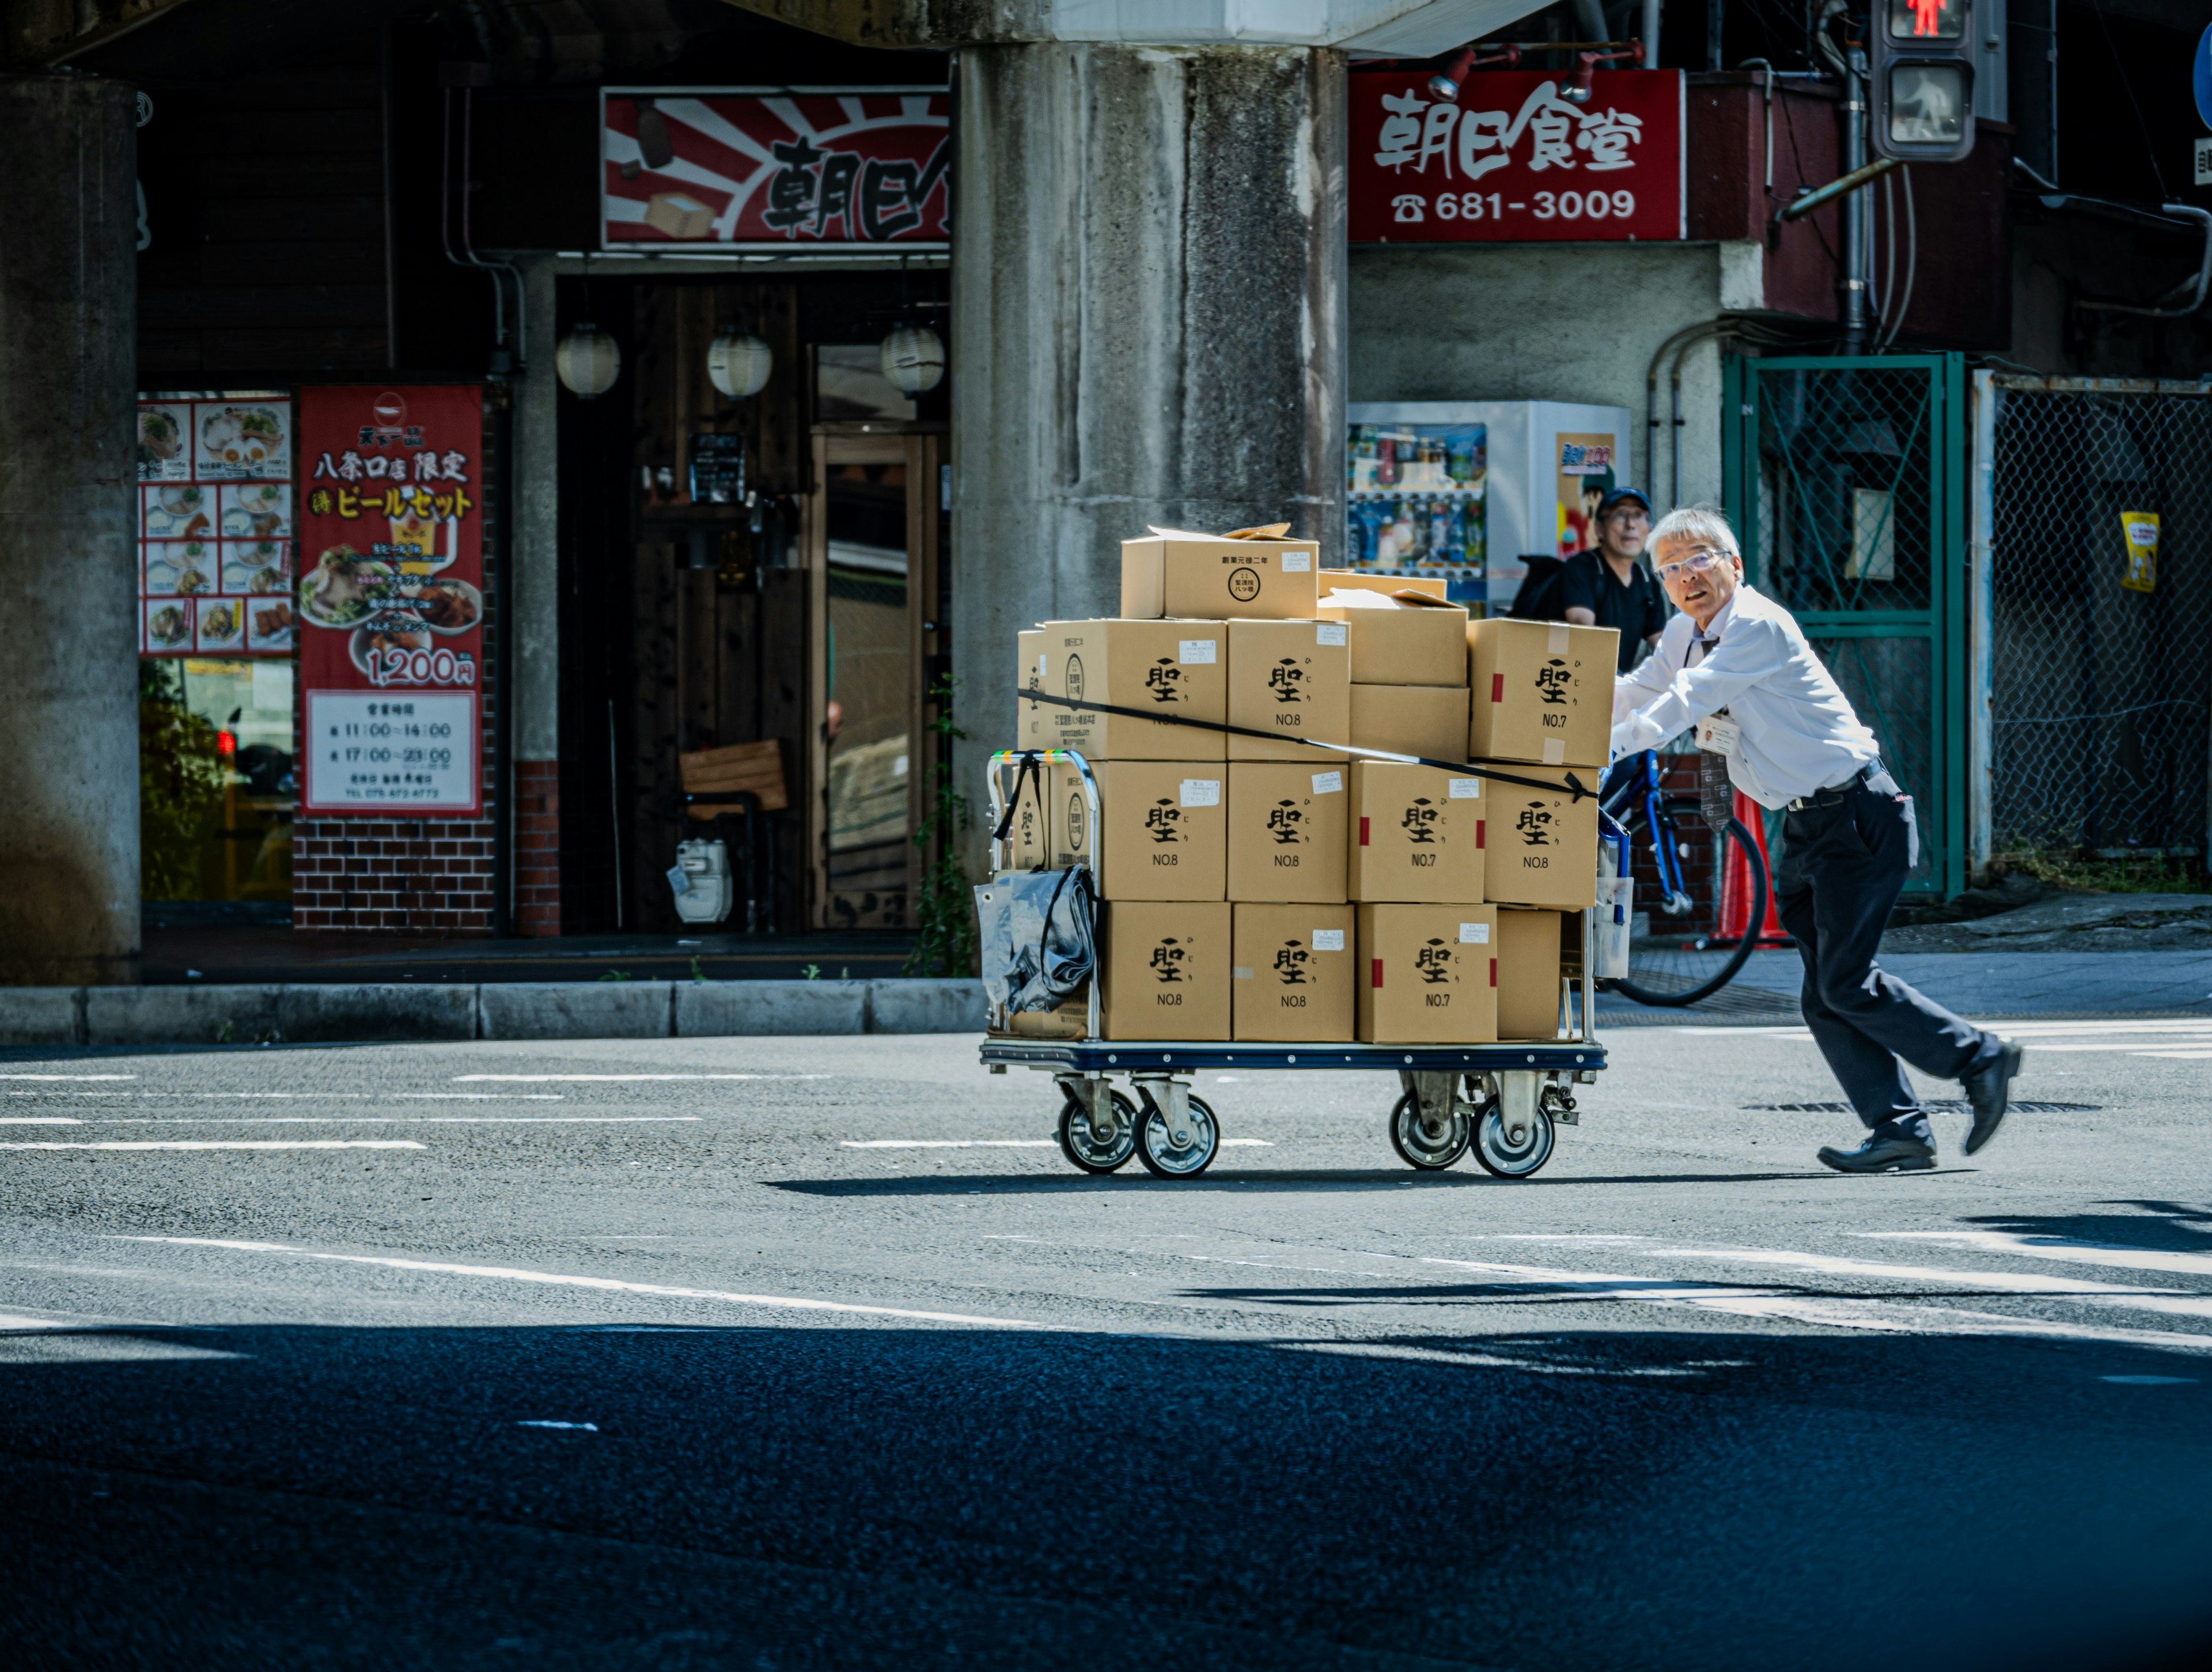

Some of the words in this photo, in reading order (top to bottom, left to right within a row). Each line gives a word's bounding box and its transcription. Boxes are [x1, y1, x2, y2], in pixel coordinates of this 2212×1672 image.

[1373, 81, 1644, 180] 朝日食堂
[762, 135, 950, 240] 朝日
[1434, 189, 1635, 221] 681-3009
[412, 449, 469, 483] 限定
[337, 486, 472, 519] ビールセット
[1145, 657, 1181, 703] 聖
[1268, 657, 1304, 703] 聖
[1535, 658, 1571, 704] 聖
[1573, 660, 1581, 706] ひじり
[1275, 714, 1301, 726] NO.8
[1543, 713, 1567, 728] NO.7
[1145, 798, 1181, 843] 聖
[1267, 799, 1302, 844] 聖
[1401, 798, 1439, 844] 聖
[1440, 797, 1448, 844] ひじり
[1516, 801, 1553, 846] 聖
[1153, 854, 1179, 866] NO.8
[1274, 855, 1300, 867] NO.8
[1411, 854, 1437, 867] NO.7
[1523, 856, 1549, 869] NO.8
[1150, 937, 1185, 984] 聖
[1273, 939, 1309, 985] 聖
[1414, 938, 1452, 984] 聖
[1157, 994, 1183, 1006] NO.8
[1281, 995, 1306, 1007] NO.8
[1426, 994, 1451, 1007] NO.7
